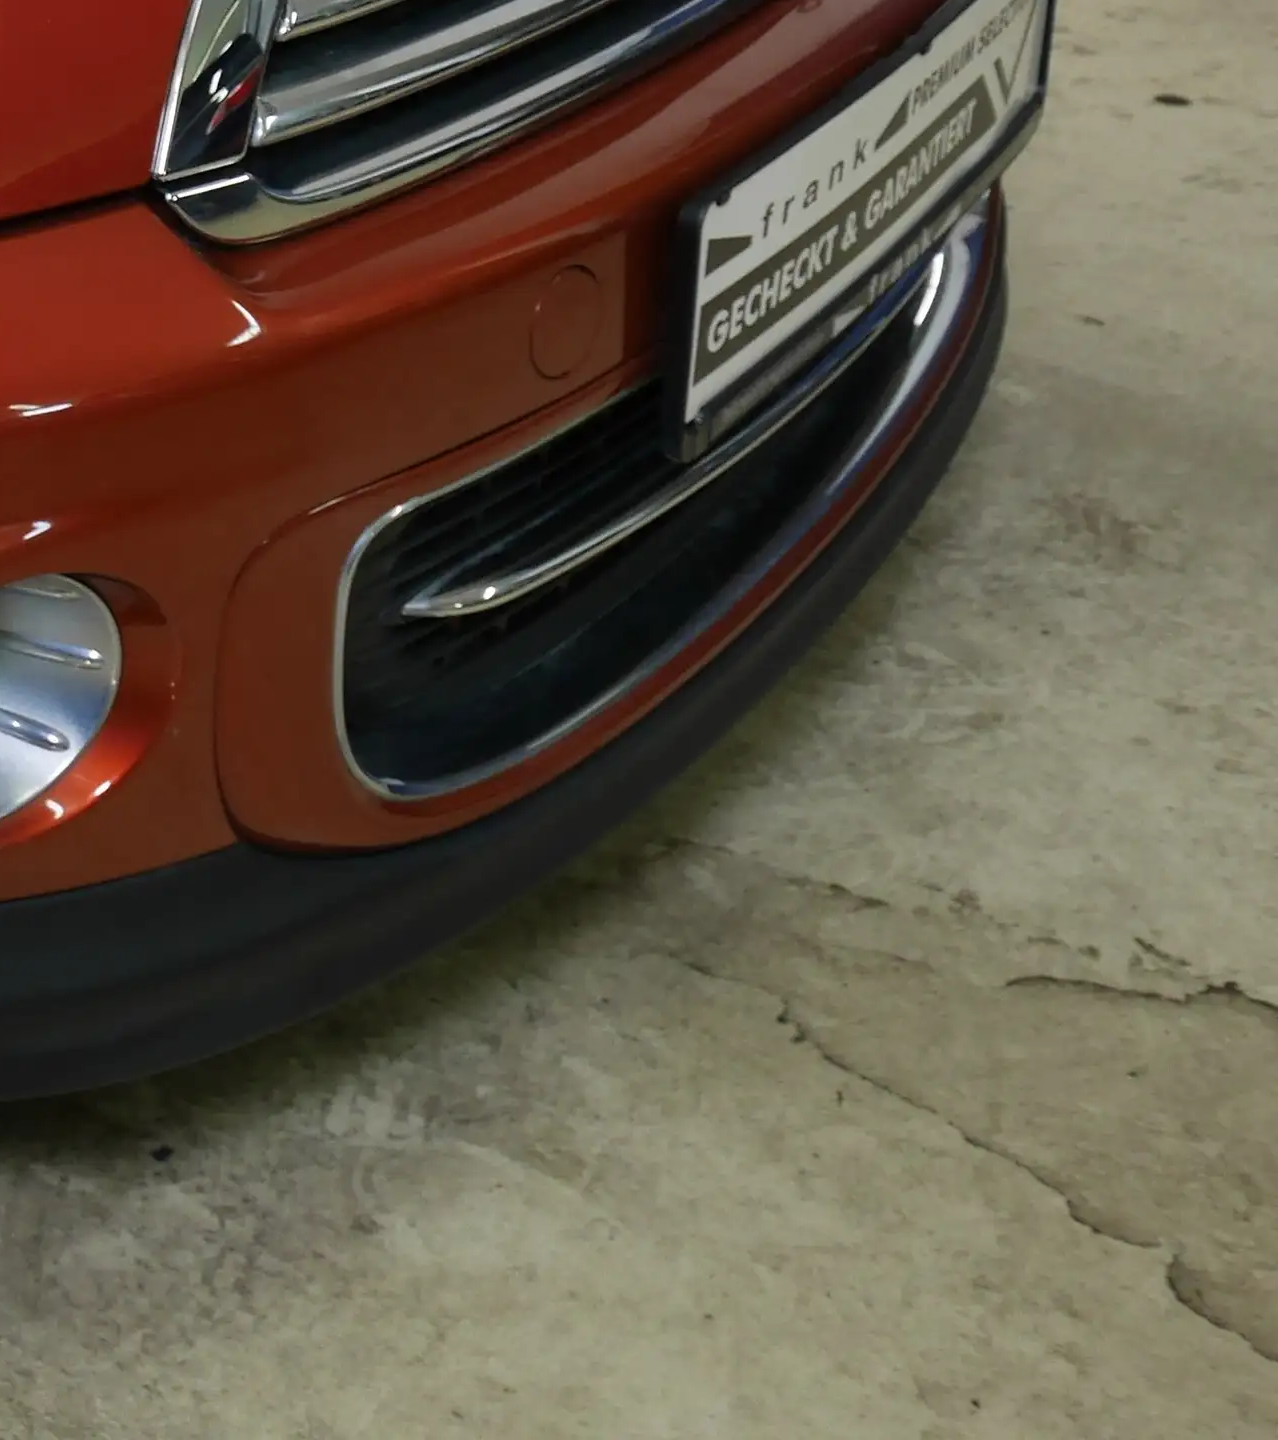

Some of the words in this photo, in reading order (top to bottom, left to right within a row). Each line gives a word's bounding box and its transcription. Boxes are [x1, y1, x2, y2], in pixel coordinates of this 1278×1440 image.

[910, 35, 976, 115] PREMIUM
[706, 225, 839, 354] GECHECKT
[840, 210, 859, 252] &
[864, 98, 978, 230] GARANTIERT
[760, 137, 870, 240] frank
